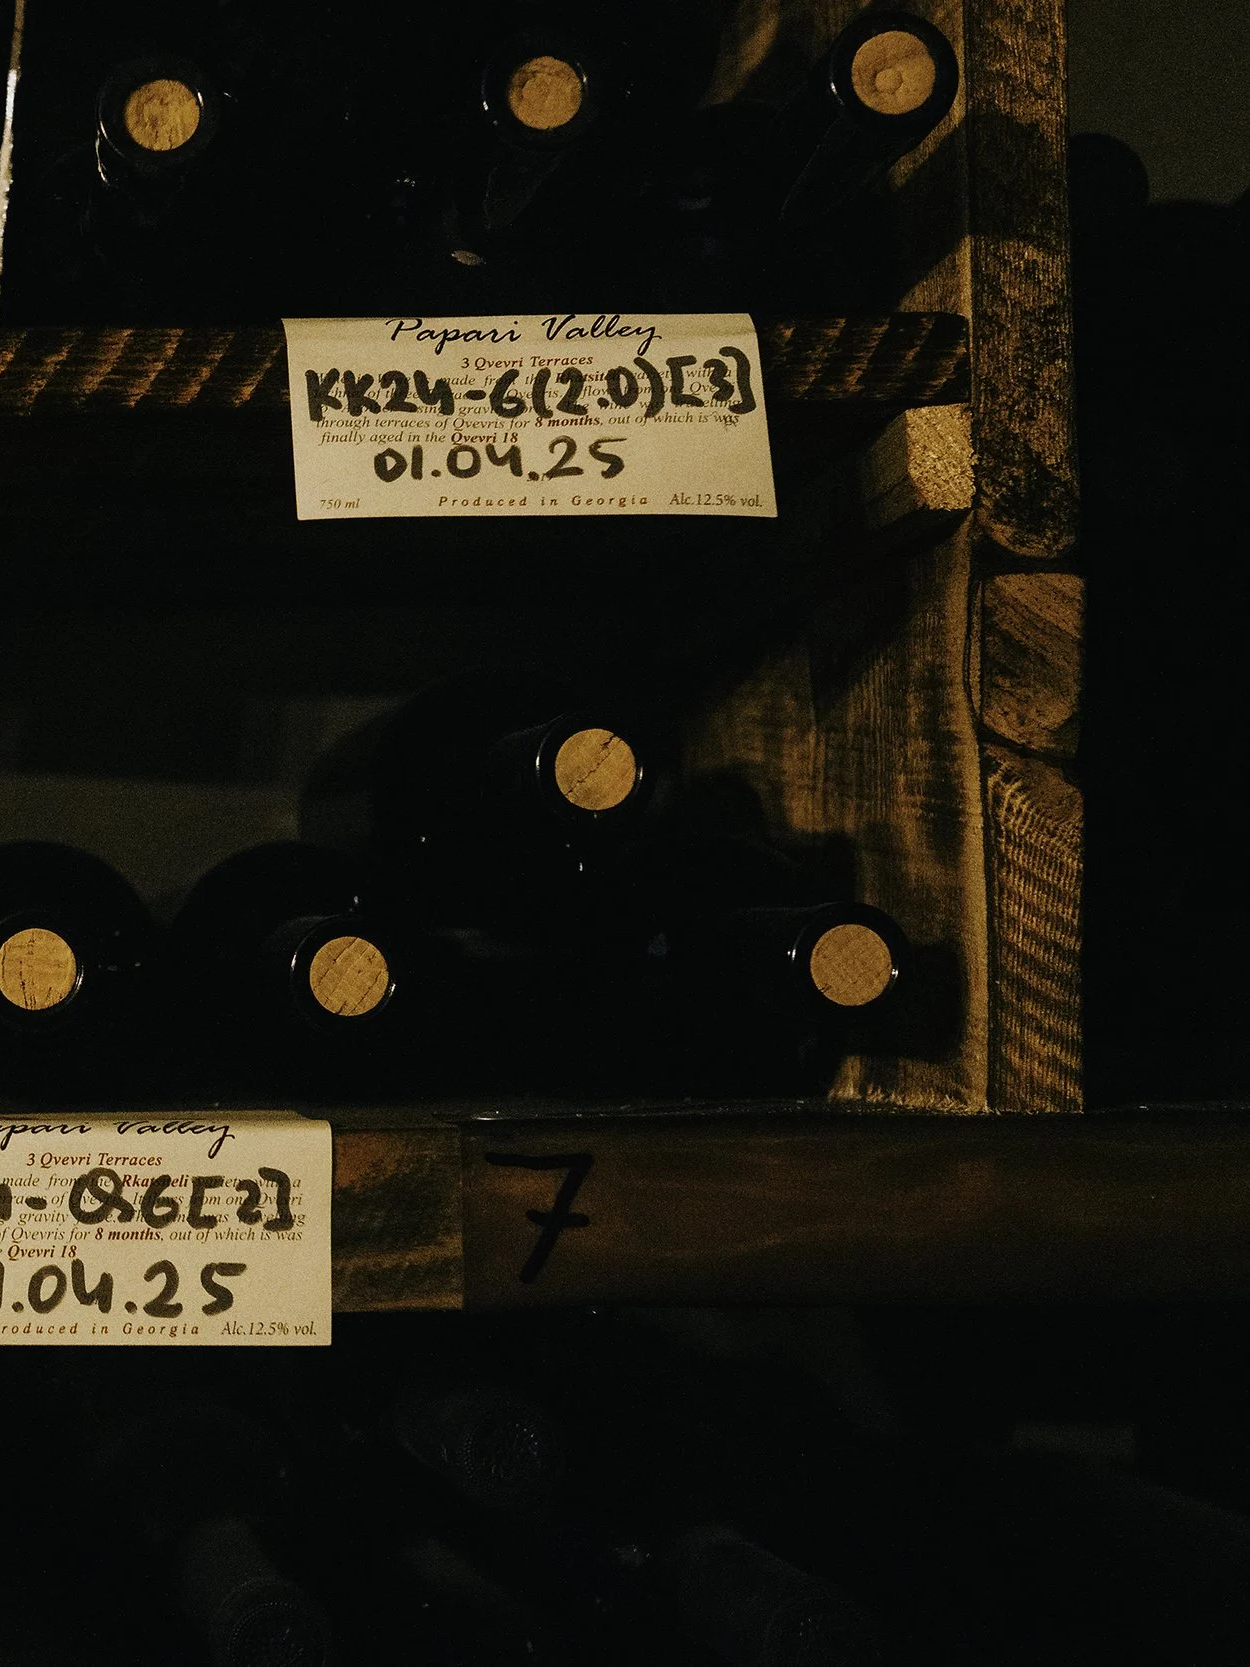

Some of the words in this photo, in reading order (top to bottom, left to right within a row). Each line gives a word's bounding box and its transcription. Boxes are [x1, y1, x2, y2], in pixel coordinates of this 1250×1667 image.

[385, 318, 522, 355] Papari
[542, 314, 662, 357] Valley
[461, 357, 470, 369] 3
[474, 357, 524, 371] Qvevri
[530, 355, 594, 369] Terraces
[316, 416, 370, 430] through
[375, 418, 430, 428] terraces
[434, 418, 449, 430] of
[452, 417, 505, 431] Qvevris
[509, 417, 530, 431] for
[608, 415, 631, 425] out
[653, 412, 693, 424] which
[698, 412, 710, 423] is
[318, 431, 366, 446] finally
[369, 431, 404, 445] aged
[407, 432, 421, 442] in
[425, 431, 446, 442] the
[451, 432, 497, 446] Qvevri
[503, 432, 519, 444] 18
[373, 435, 628, 483] 01.04.25
[319, 499, 343, 510] 750
[345, 499, 361, 509] ml
[438, 496, 528, 507] Produced
[541, 496, 559, 506] in
[571, 495, 648, 508] Georgia
[740, 495, 763, 507] vol.
[26, 1153, 36, 1166] 3
[40, 1153, 91, 1168] Qvevri
[98, 1153, 163, 1166] Terraces
[51, 1192, 68, 1208] of
[18, 1210, 68, 1226] gravity
[485, 1153, 593, 1283] 7
[11, 1226, 65, 1243] Qvevris
[67, 1226, 90, 1244] for
[95, 1227, 103, 1240] 8
[108, 1227, 164, 1241] months,
[170, 1230, 192, 1240] out
[196, 1229, 210, 1244] of
[215, 1227, 255, 1240] which
[260, 1230, 271, 1240] is
[277, 1231, 302, 1240] was
[8, 1245, 55, 1261] Qvevri
[61, 1245, 77, 1258] 18
[92, 1323, 108, 1334] in
[122, 1323, 199, 1337] Georgia
[294, 1322, 317, 1335] vol.
